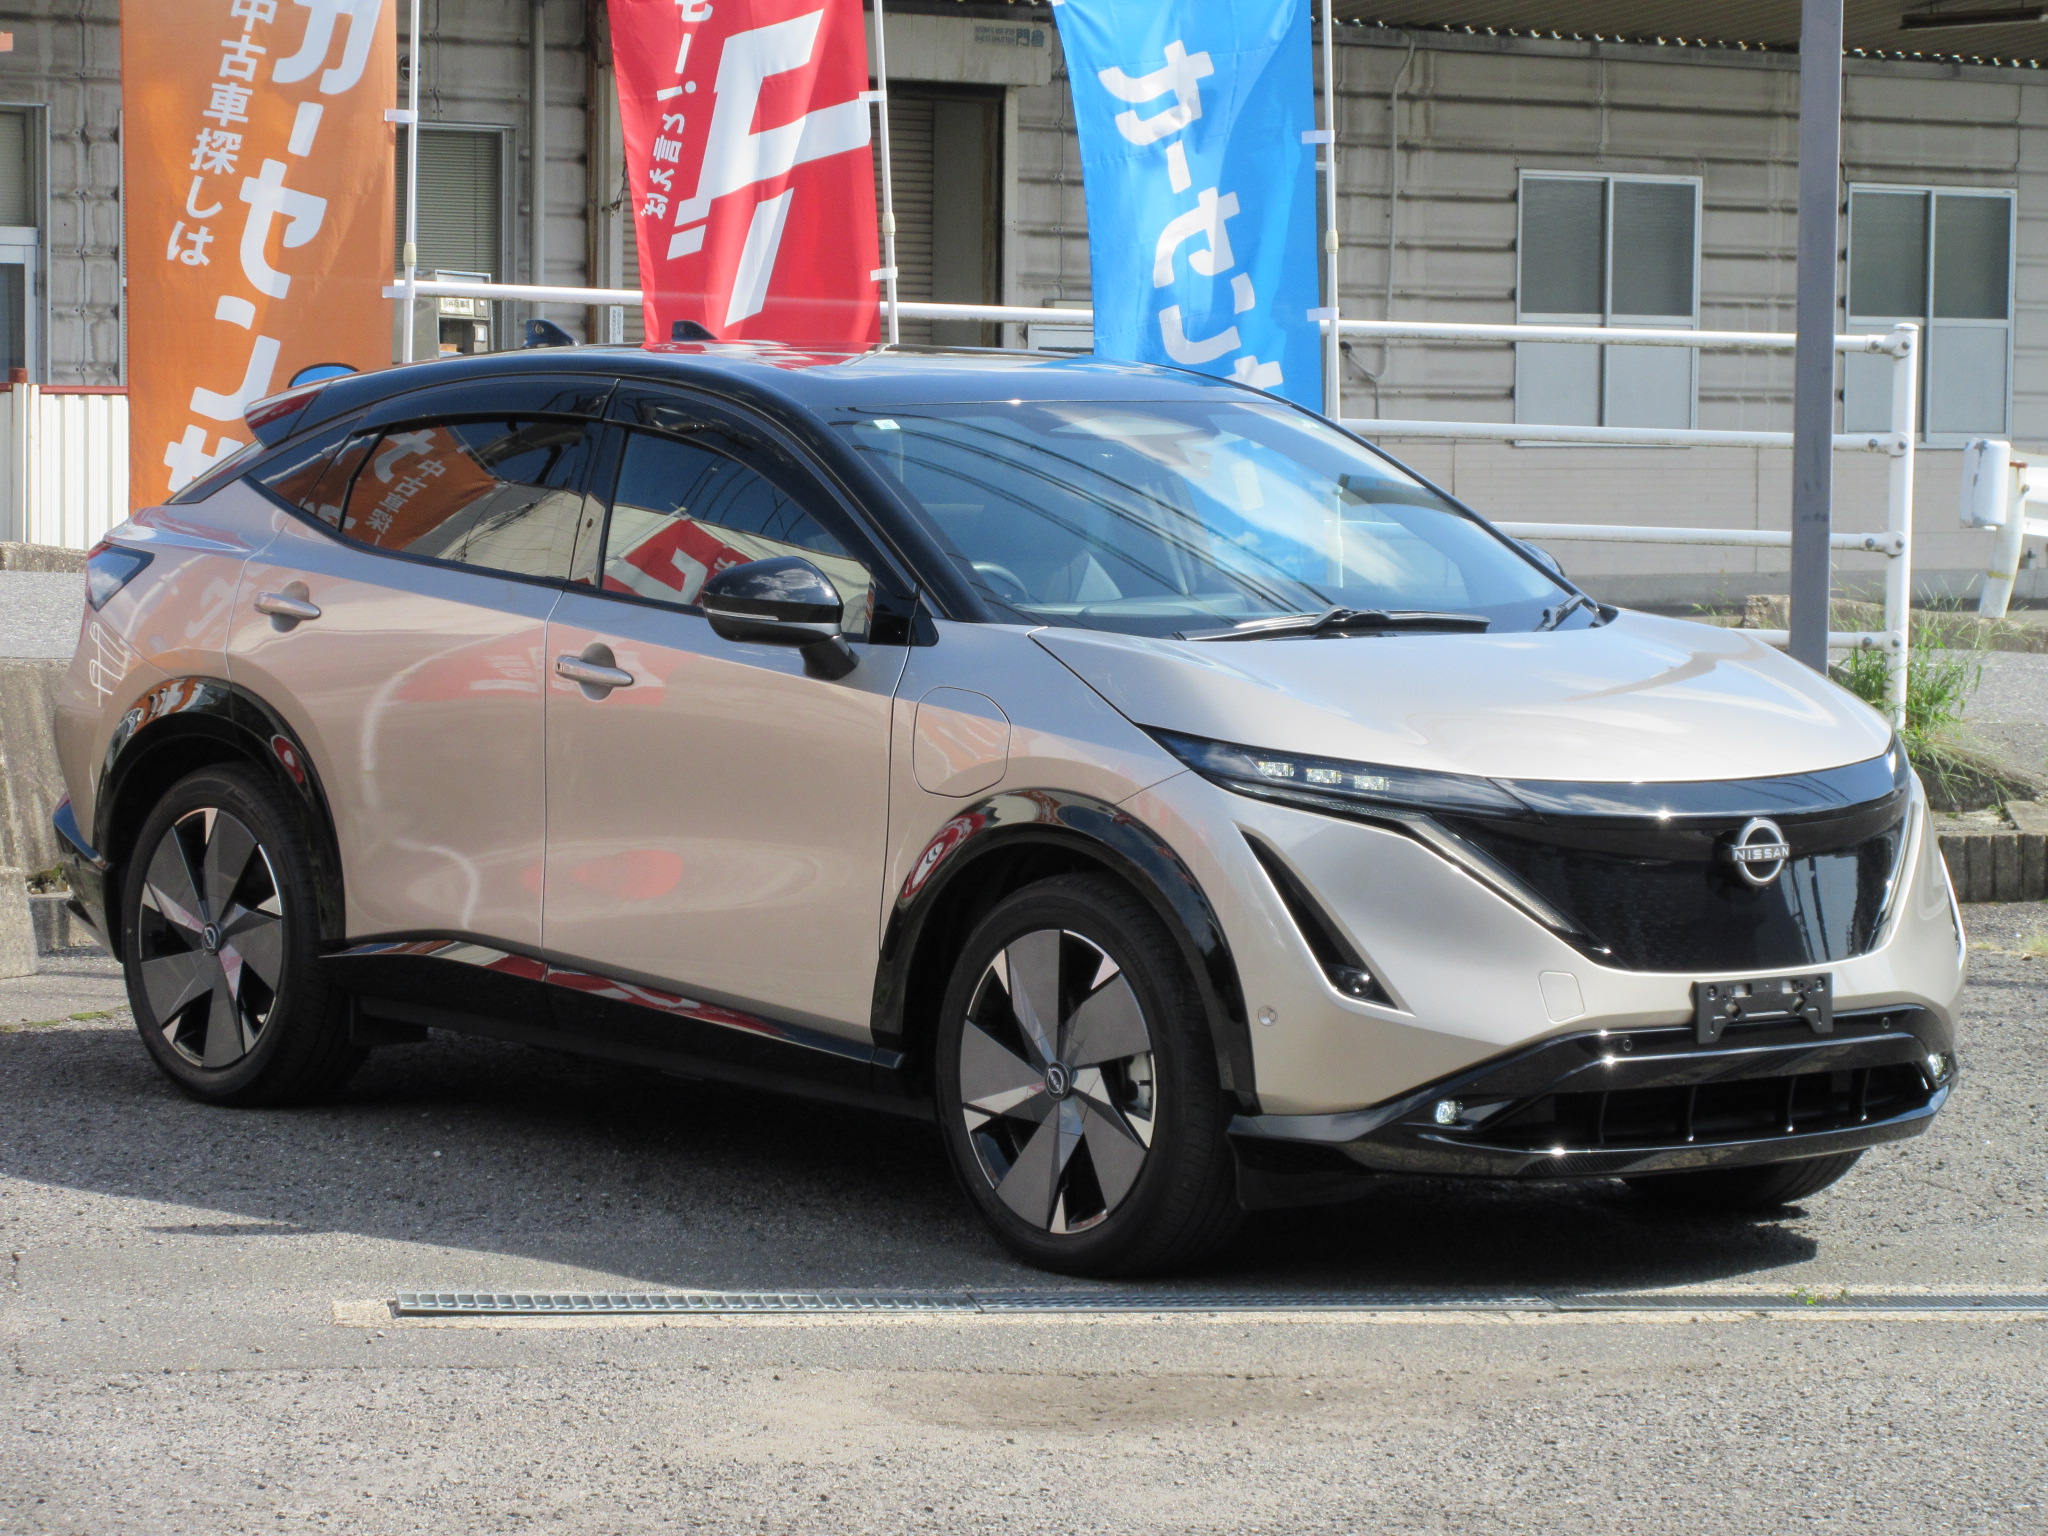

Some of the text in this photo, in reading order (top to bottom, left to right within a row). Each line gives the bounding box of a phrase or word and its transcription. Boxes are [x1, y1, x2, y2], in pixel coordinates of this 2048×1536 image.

[167, 0, 277, 266] 中古車探しは
[1734, 846, 1789, 860] NISSAN
